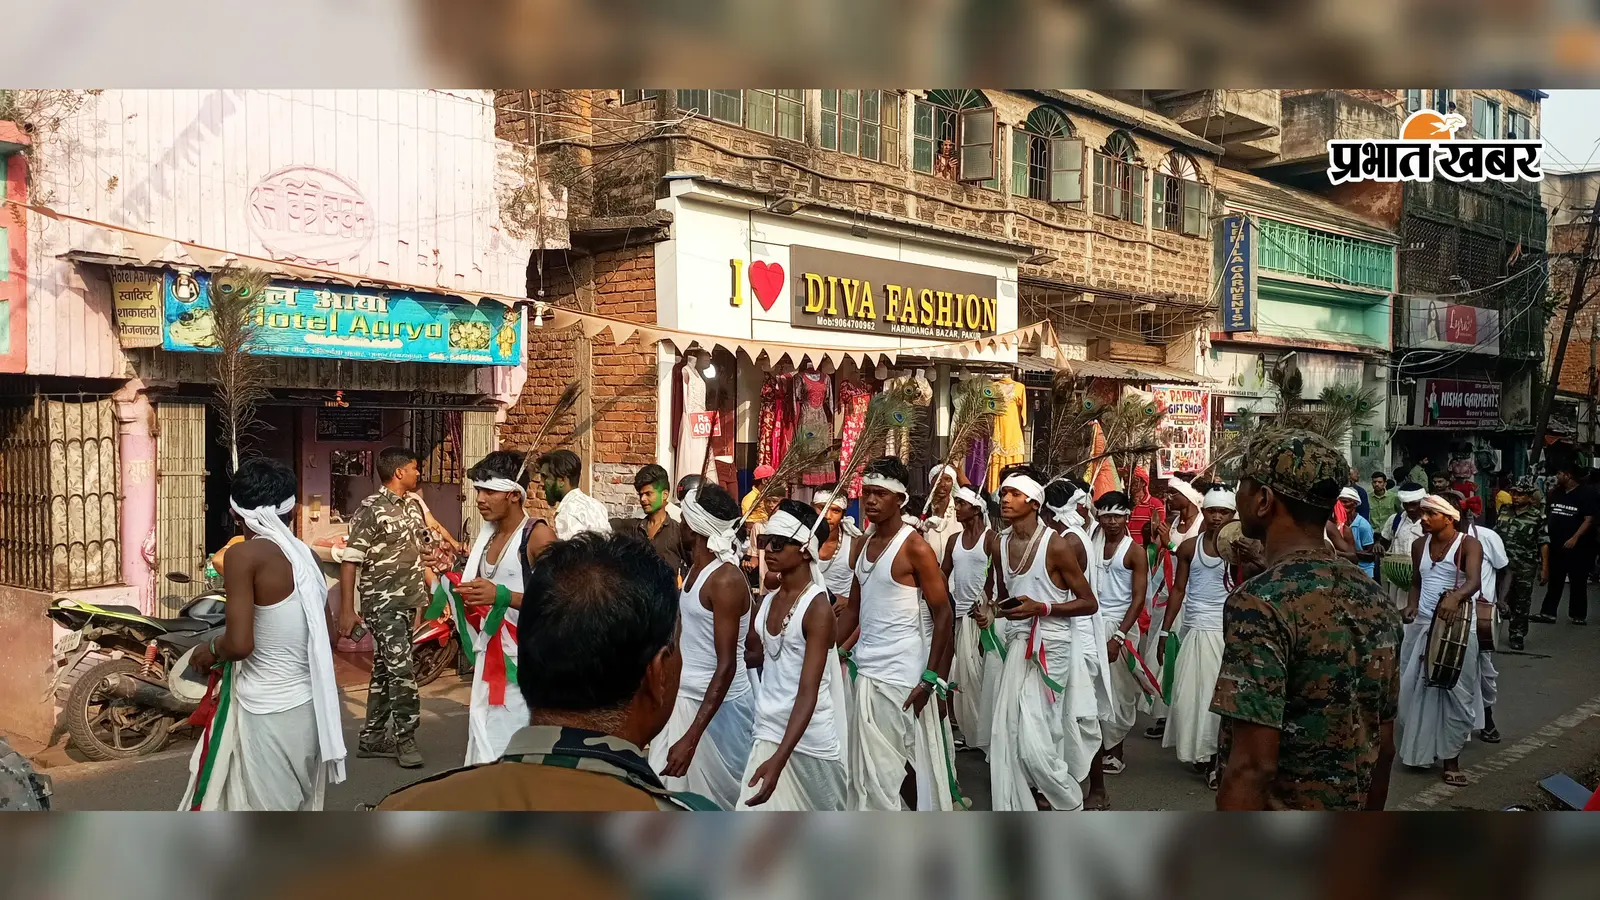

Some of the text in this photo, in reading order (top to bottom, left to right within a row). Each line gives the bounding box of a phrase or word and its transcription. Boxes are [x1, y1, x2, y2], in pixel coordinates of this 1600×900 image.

[112, 267, 132, 284] Hotel
[730, 259, 743, 307] I
[119, 288, 153, 301] स्वादिष्ट
[313, 290, 390, 313] आर्या
[1230, 265, 1245, 321] GARMENTS
[802, 272, 997, 332] DIVA FASHION
[118, 305, 156, 318] शाकाहारी
[119, 322, 159, 335] भोजनालय
[349, 314, 442, 340] Aarya
[817, 316, 875, 330] Mob:9064700962
[1449, 309, 1469, 339] Lyra
[891, 324, 981, 340] HARINDANGA BAZAR, PAKUR
[1170, 390, 1199, 403] PAPPU
[1441, 391, 1499, 408] NISHA GARMENTS
[1168, 403, 1202, 415] GIFT SHOP
